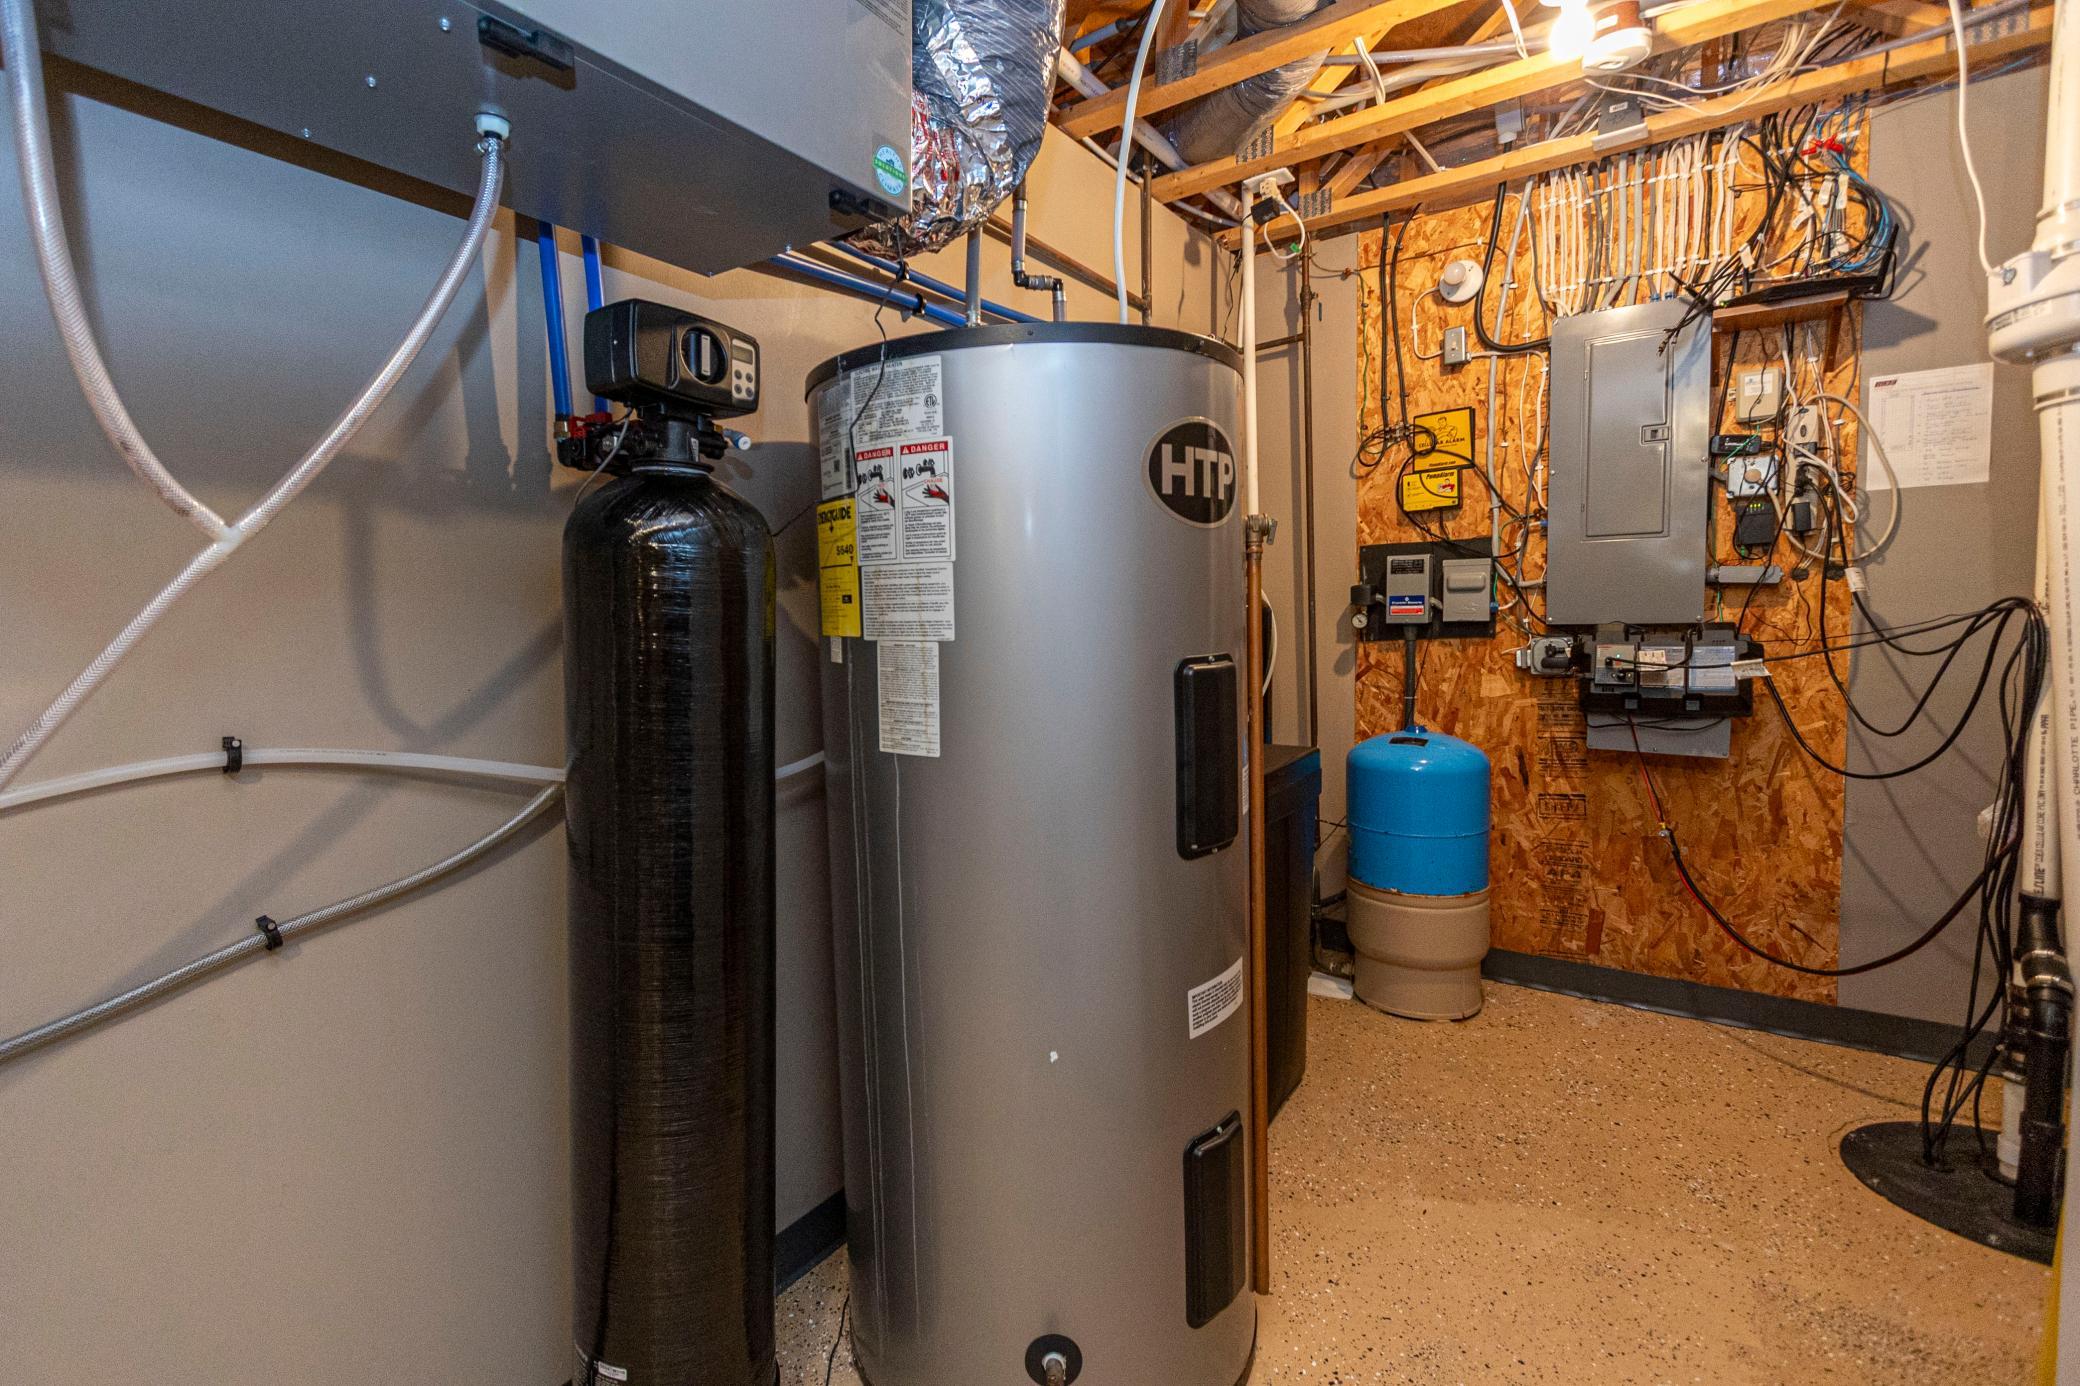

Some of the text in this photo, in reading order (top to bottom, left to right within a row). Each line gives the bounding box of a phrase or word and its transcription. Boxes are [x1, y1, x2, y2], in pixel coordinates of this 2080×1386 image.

[863, 448, 891, 460] DANGER
[910, 442, 945, 453] DANGER
[1162, 443, 1234, 500] HTP
[2071, 736, 2080, 795] CHARLOTTE
